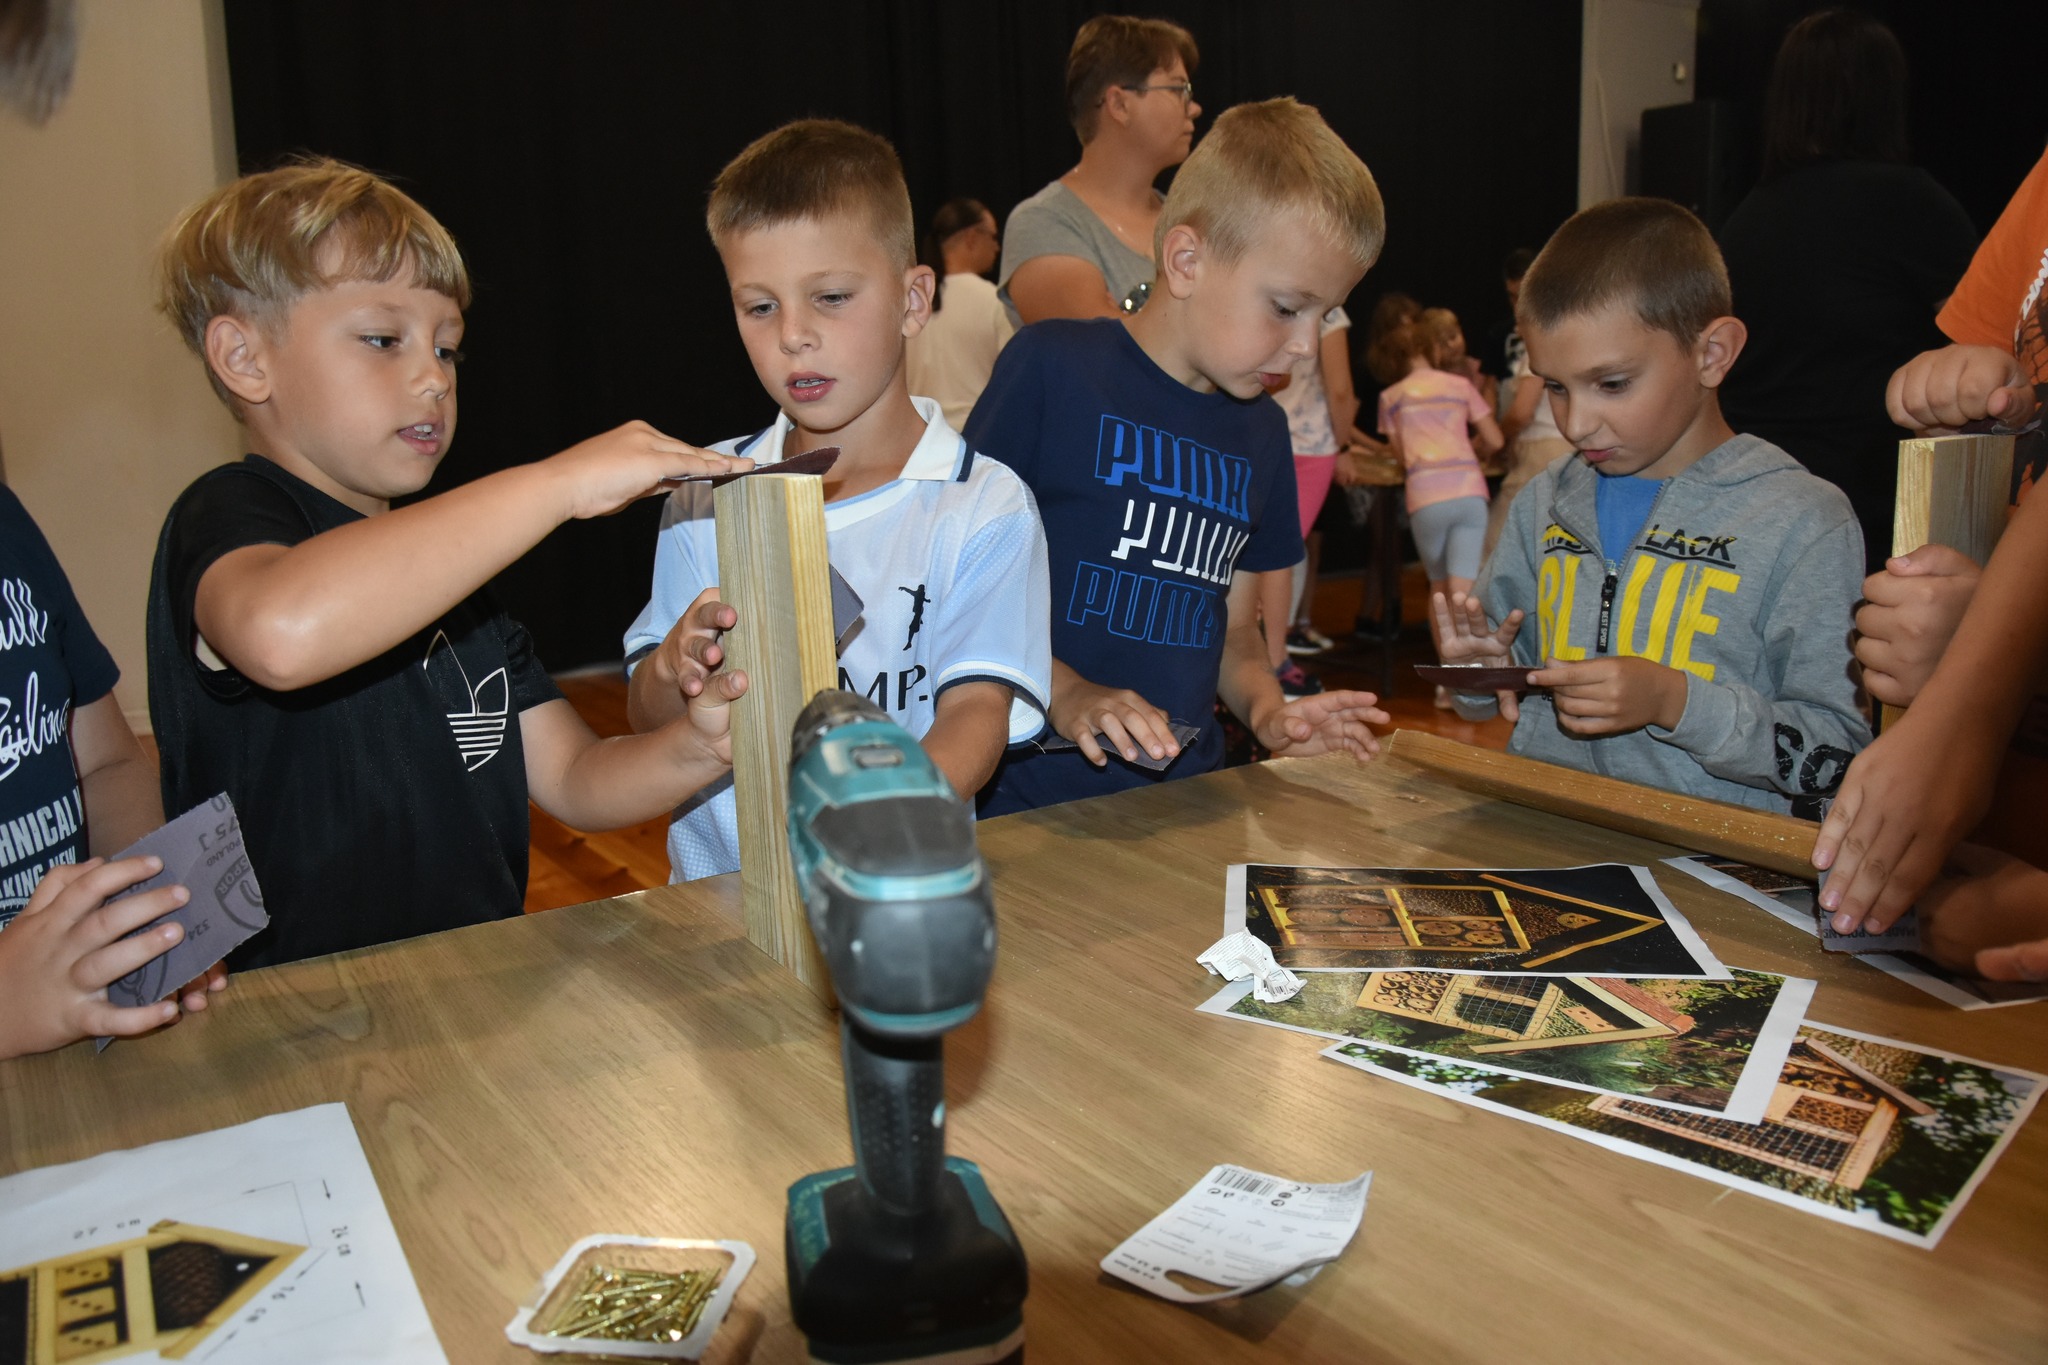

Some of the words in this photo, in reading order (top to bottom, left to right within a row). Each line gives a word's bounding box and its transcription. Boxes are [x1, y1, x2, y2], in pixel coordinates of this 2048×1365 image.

[1095, 414, 1251, 522] PUMA
[1111, 499, 1249, 586] PUMA
[1067, 561, 1219, 649] PUMA
[1601, 610, 1609, 627] BEST
[1600, 628, 1608, 648] SPORT
[206, 837, 242, 867] POLAND
